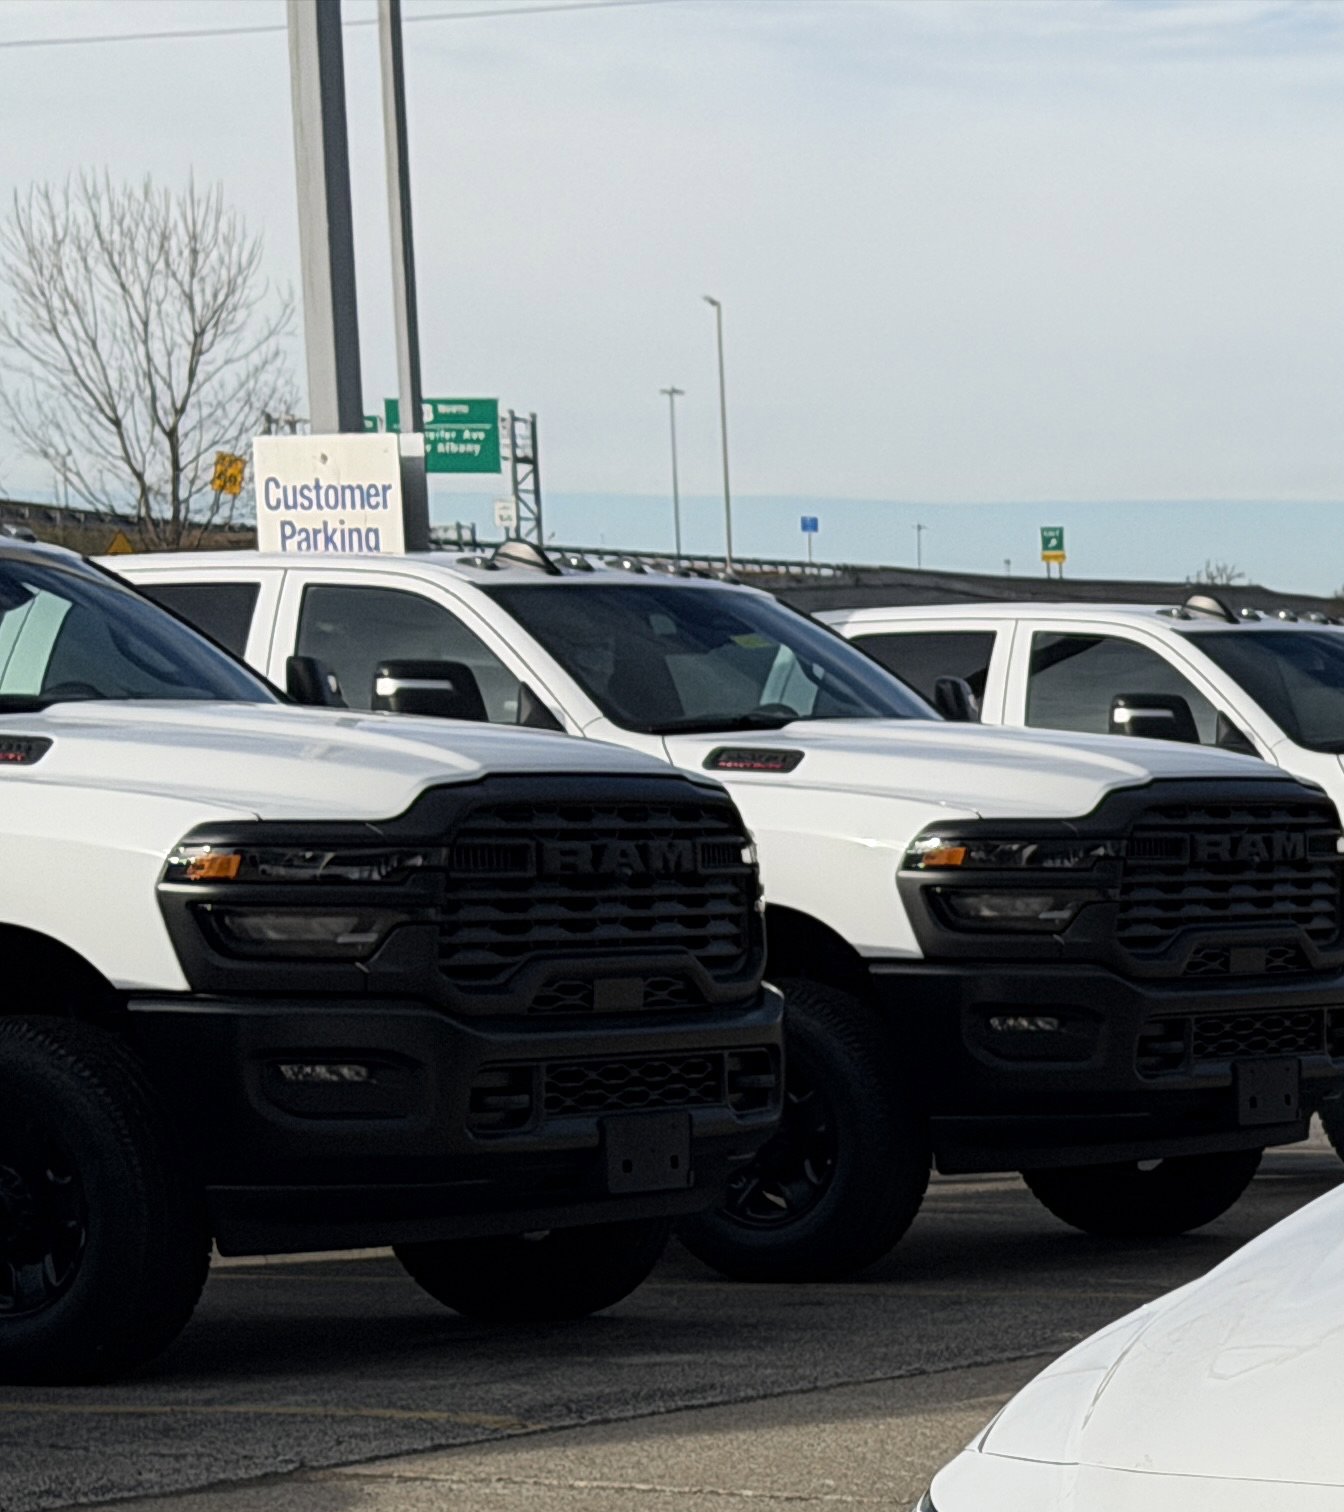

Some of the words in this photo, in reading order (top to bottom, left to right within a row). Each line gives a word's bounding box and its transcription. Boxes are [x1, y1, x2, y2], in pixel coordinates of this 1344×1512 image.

[264, 476, 393, 512] Customer
[541, 839, 696, 874] RAM
[1193, 832, 1306, 862] RAM
